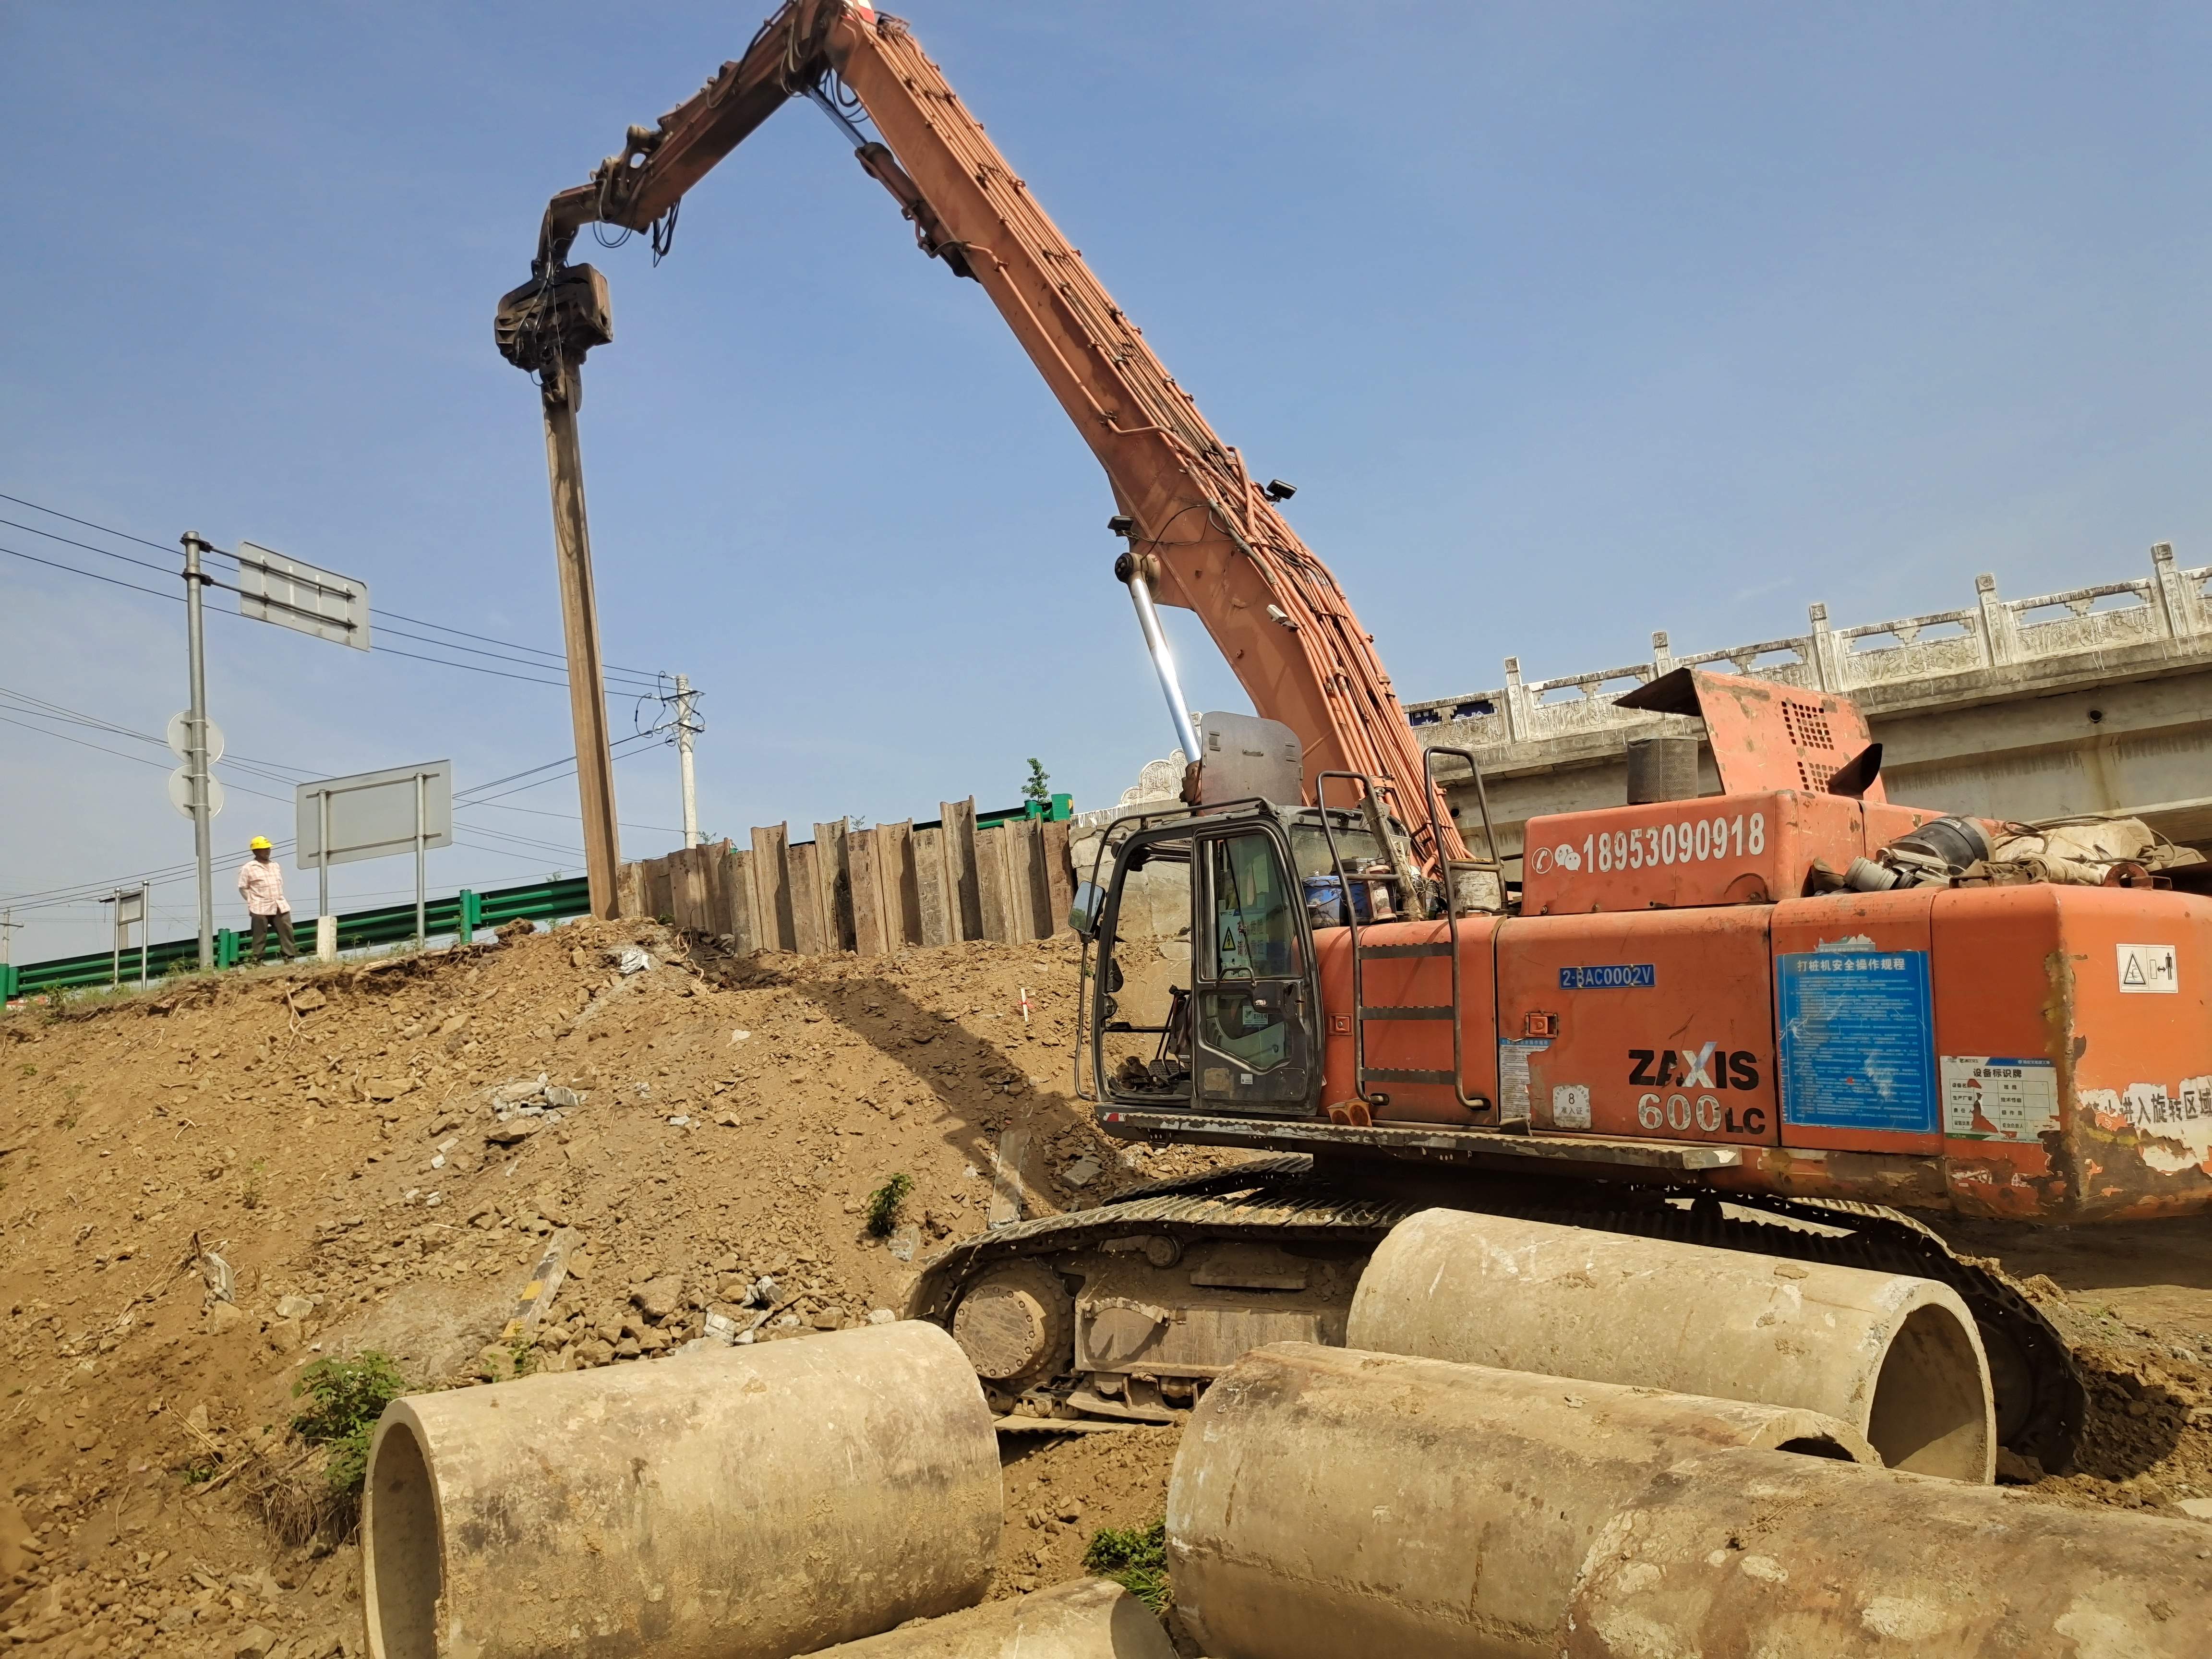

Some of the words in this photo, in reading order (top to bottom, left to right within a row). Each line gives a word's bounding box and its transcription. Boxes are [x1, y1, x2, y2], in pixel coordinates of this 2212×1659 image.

[1583, 812, 1765, 873] 18953090918
[1797, 958, 1905, 972] 打桩机安全操作规程
[1563, 966, 1651, 986] 2-BAC0002V
[1628, 1041, 1759, 1090] ZAXIS
[1973, 1068, 2022, 1079] 设备标识牌
[1569, 1093, 1575, 1105] 8
[1561, 1106, 1583, 1115] 准入证
